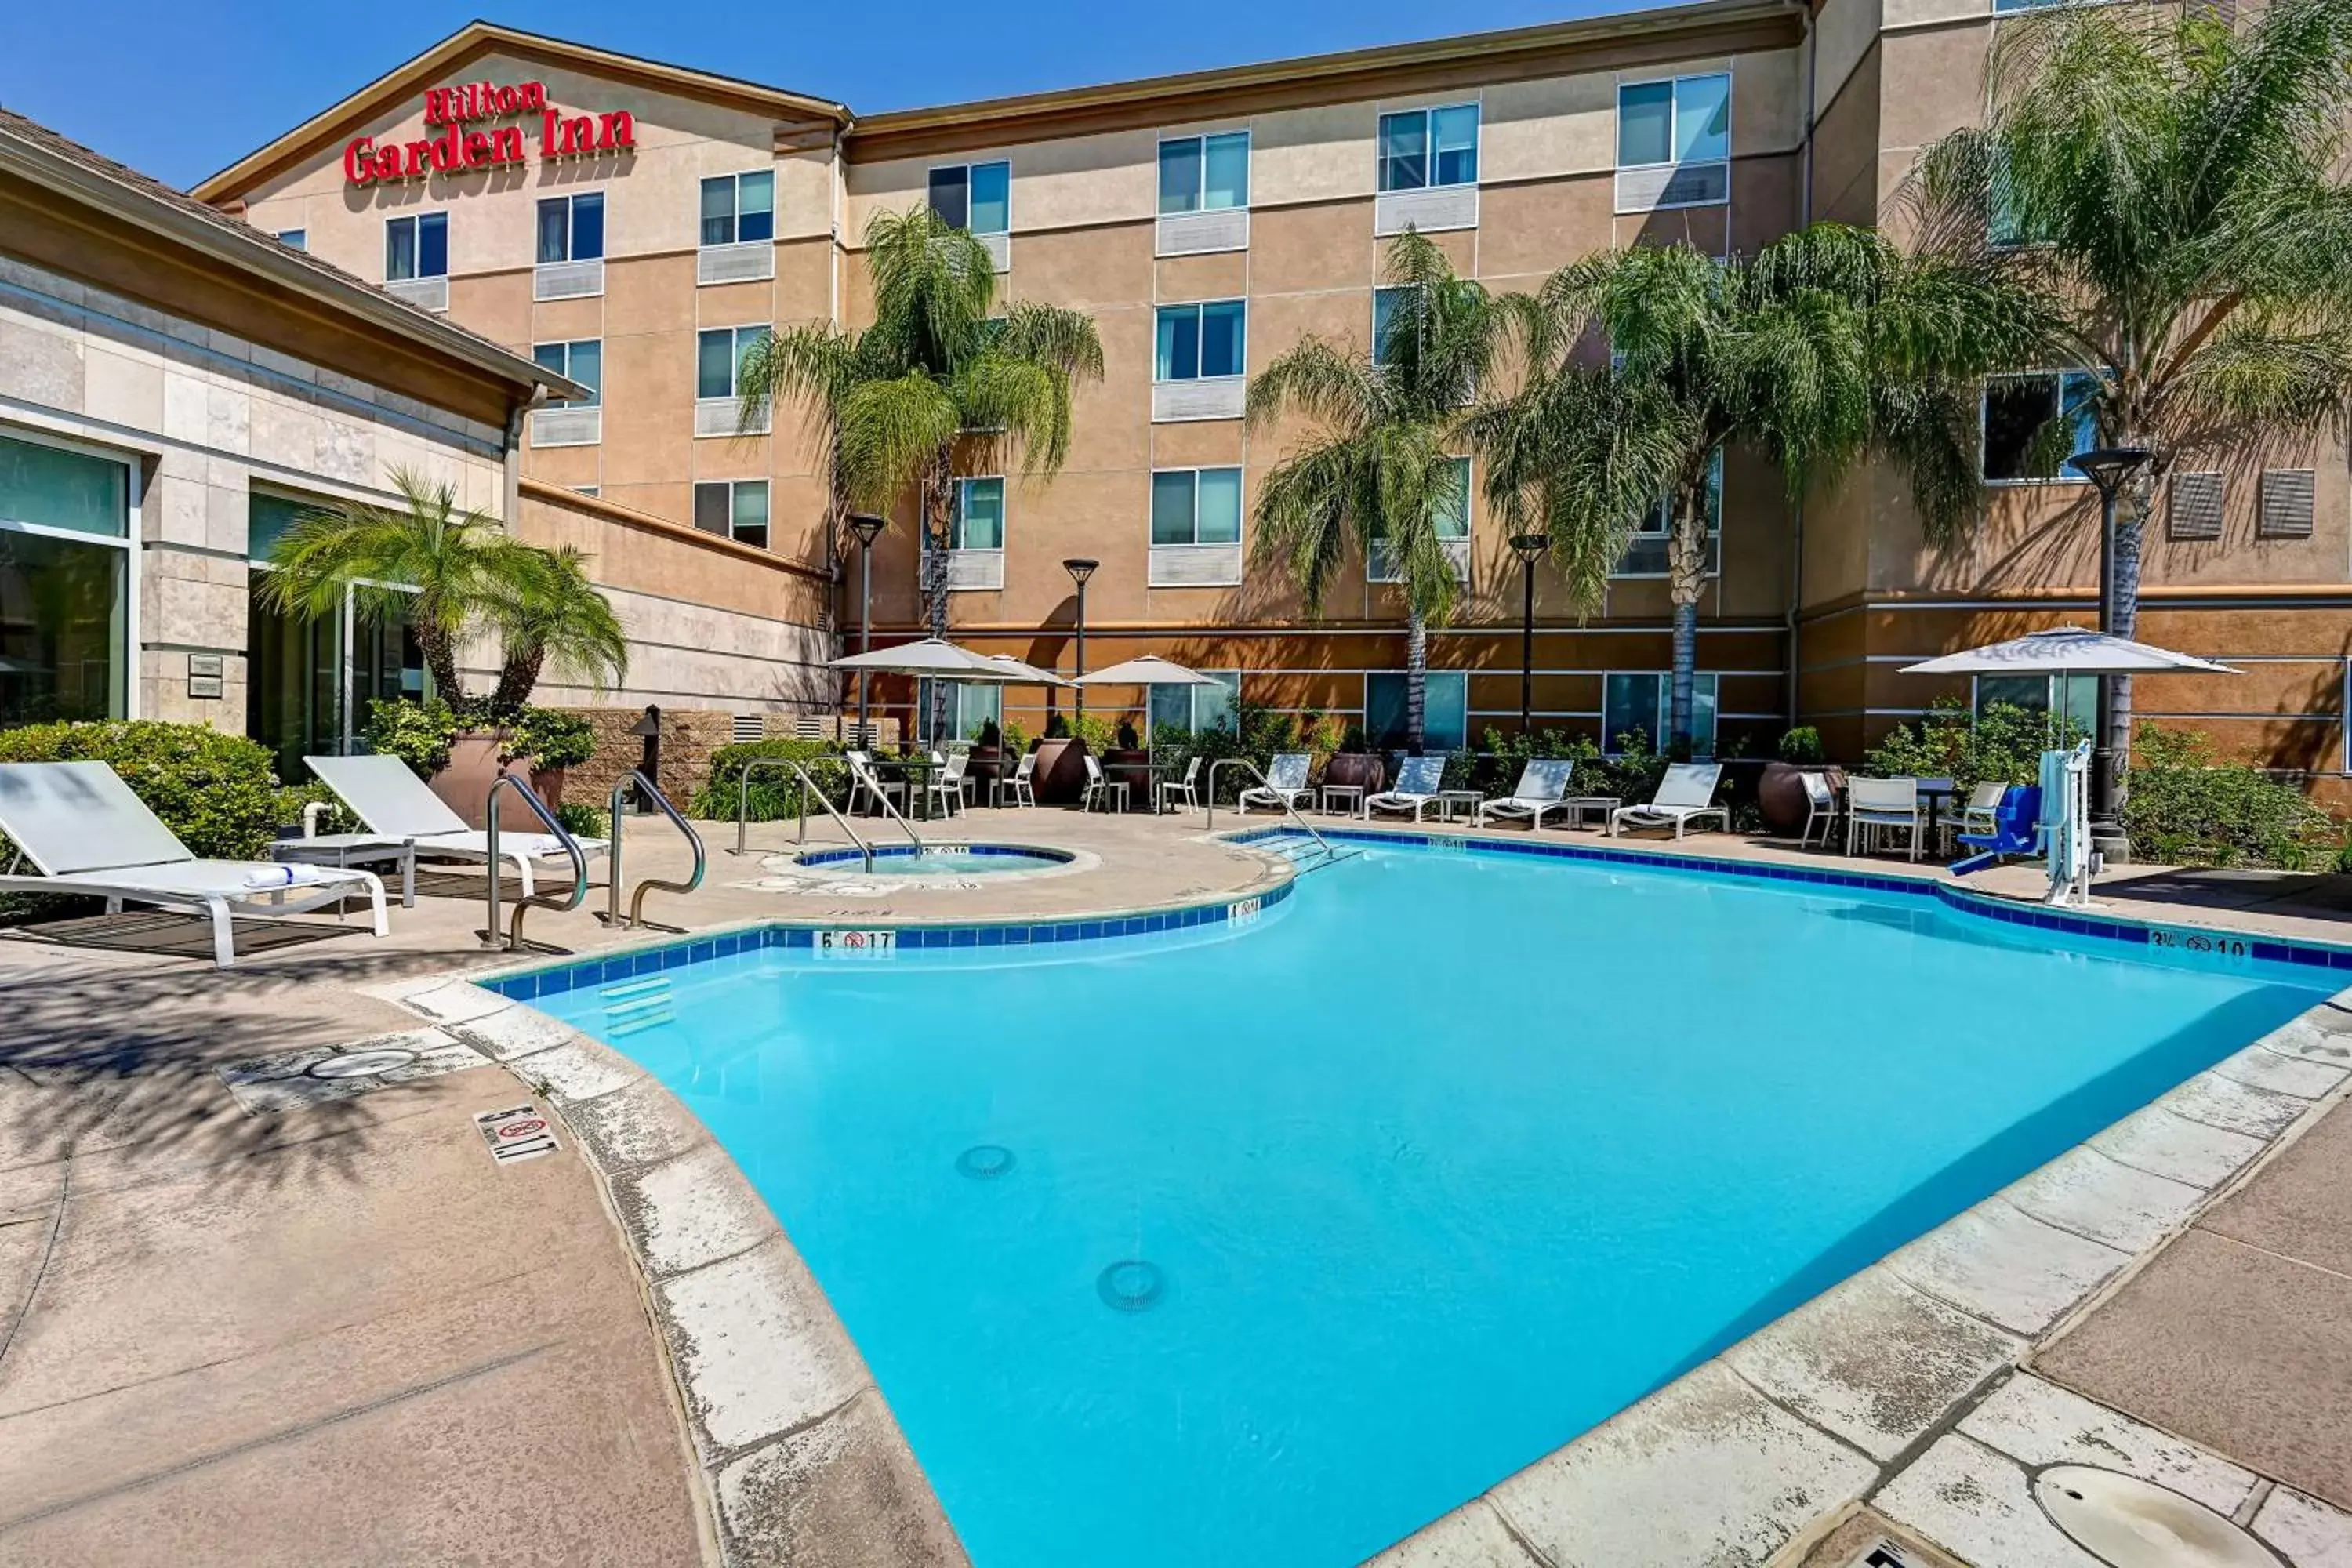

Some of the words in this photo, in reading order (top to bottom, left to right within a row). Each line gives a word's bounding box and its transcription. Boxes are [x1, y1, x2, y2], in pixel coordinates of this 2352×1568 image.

[424, 81, 546, 124] Hilton
[343, 125, 525, 184] Garden
[539, 108, 637, 157] Inn
